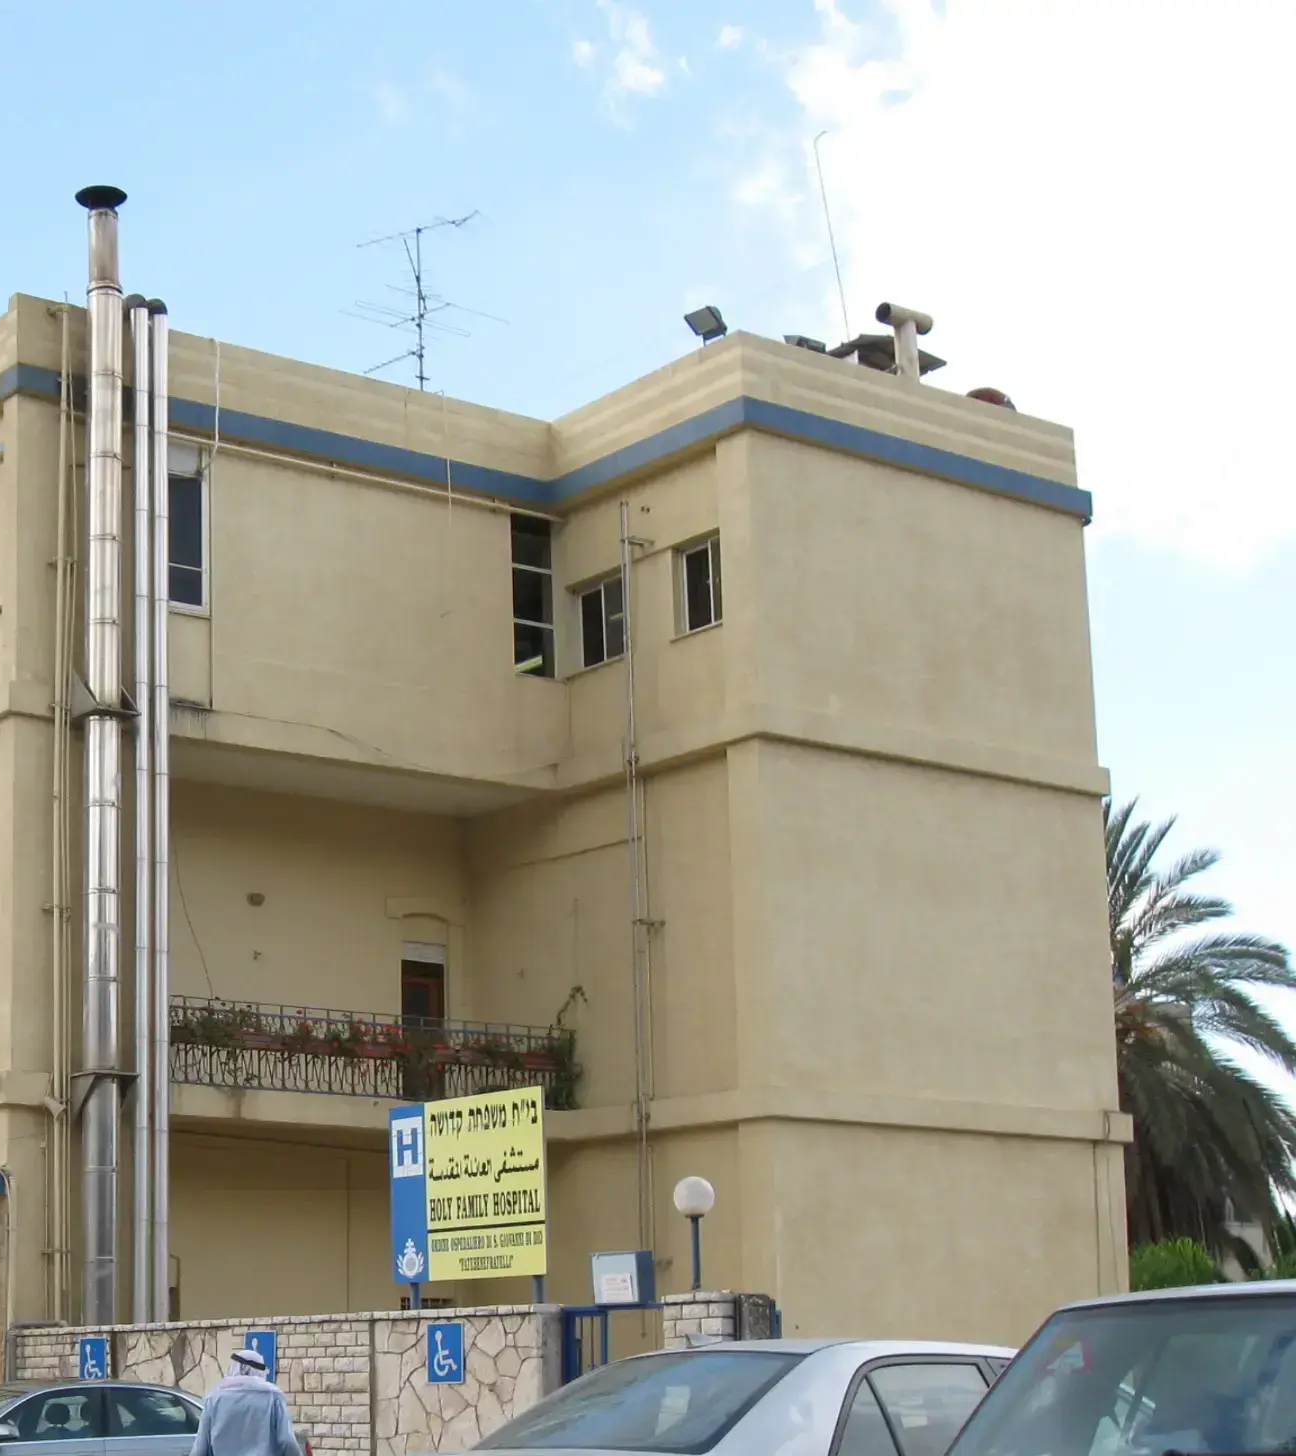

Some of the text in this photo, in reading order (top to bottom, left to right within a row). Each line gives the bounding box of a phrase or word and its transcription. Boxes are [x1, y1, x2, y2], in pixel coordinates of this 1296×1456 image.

[430, 1110, 463, 1140] קדושה
[397, 1127, 418, 1167] H
[494, 1146, 540, 1183] مستشفى
[430, 1188, 541, 1222] HOLY FAMILY HOSPITAL
[493, 1234, 499, 1248] S.
